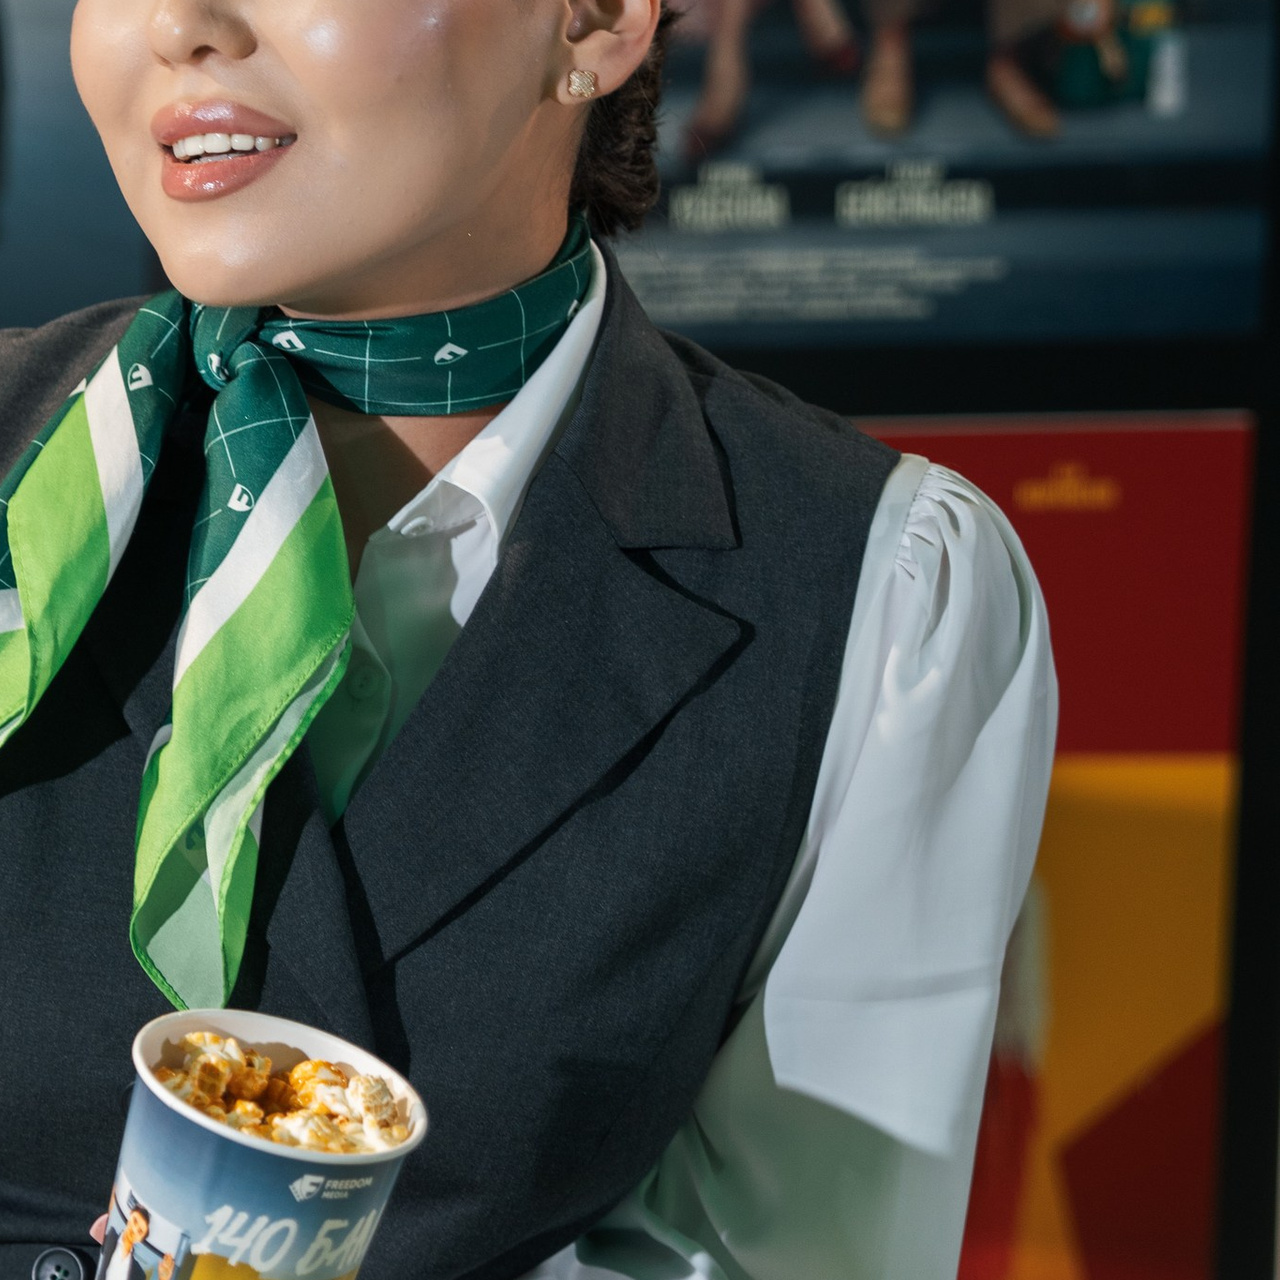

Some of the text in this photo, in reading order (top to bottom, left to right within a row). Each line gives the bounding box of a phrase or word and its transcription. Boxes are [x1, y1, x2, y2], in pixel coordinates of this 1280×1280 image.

[324, 1177, 373, 1190] FREEDOM
[321, 1190, 349, 1199] MEDIA
[191, 1204, 298, 1272] 140
